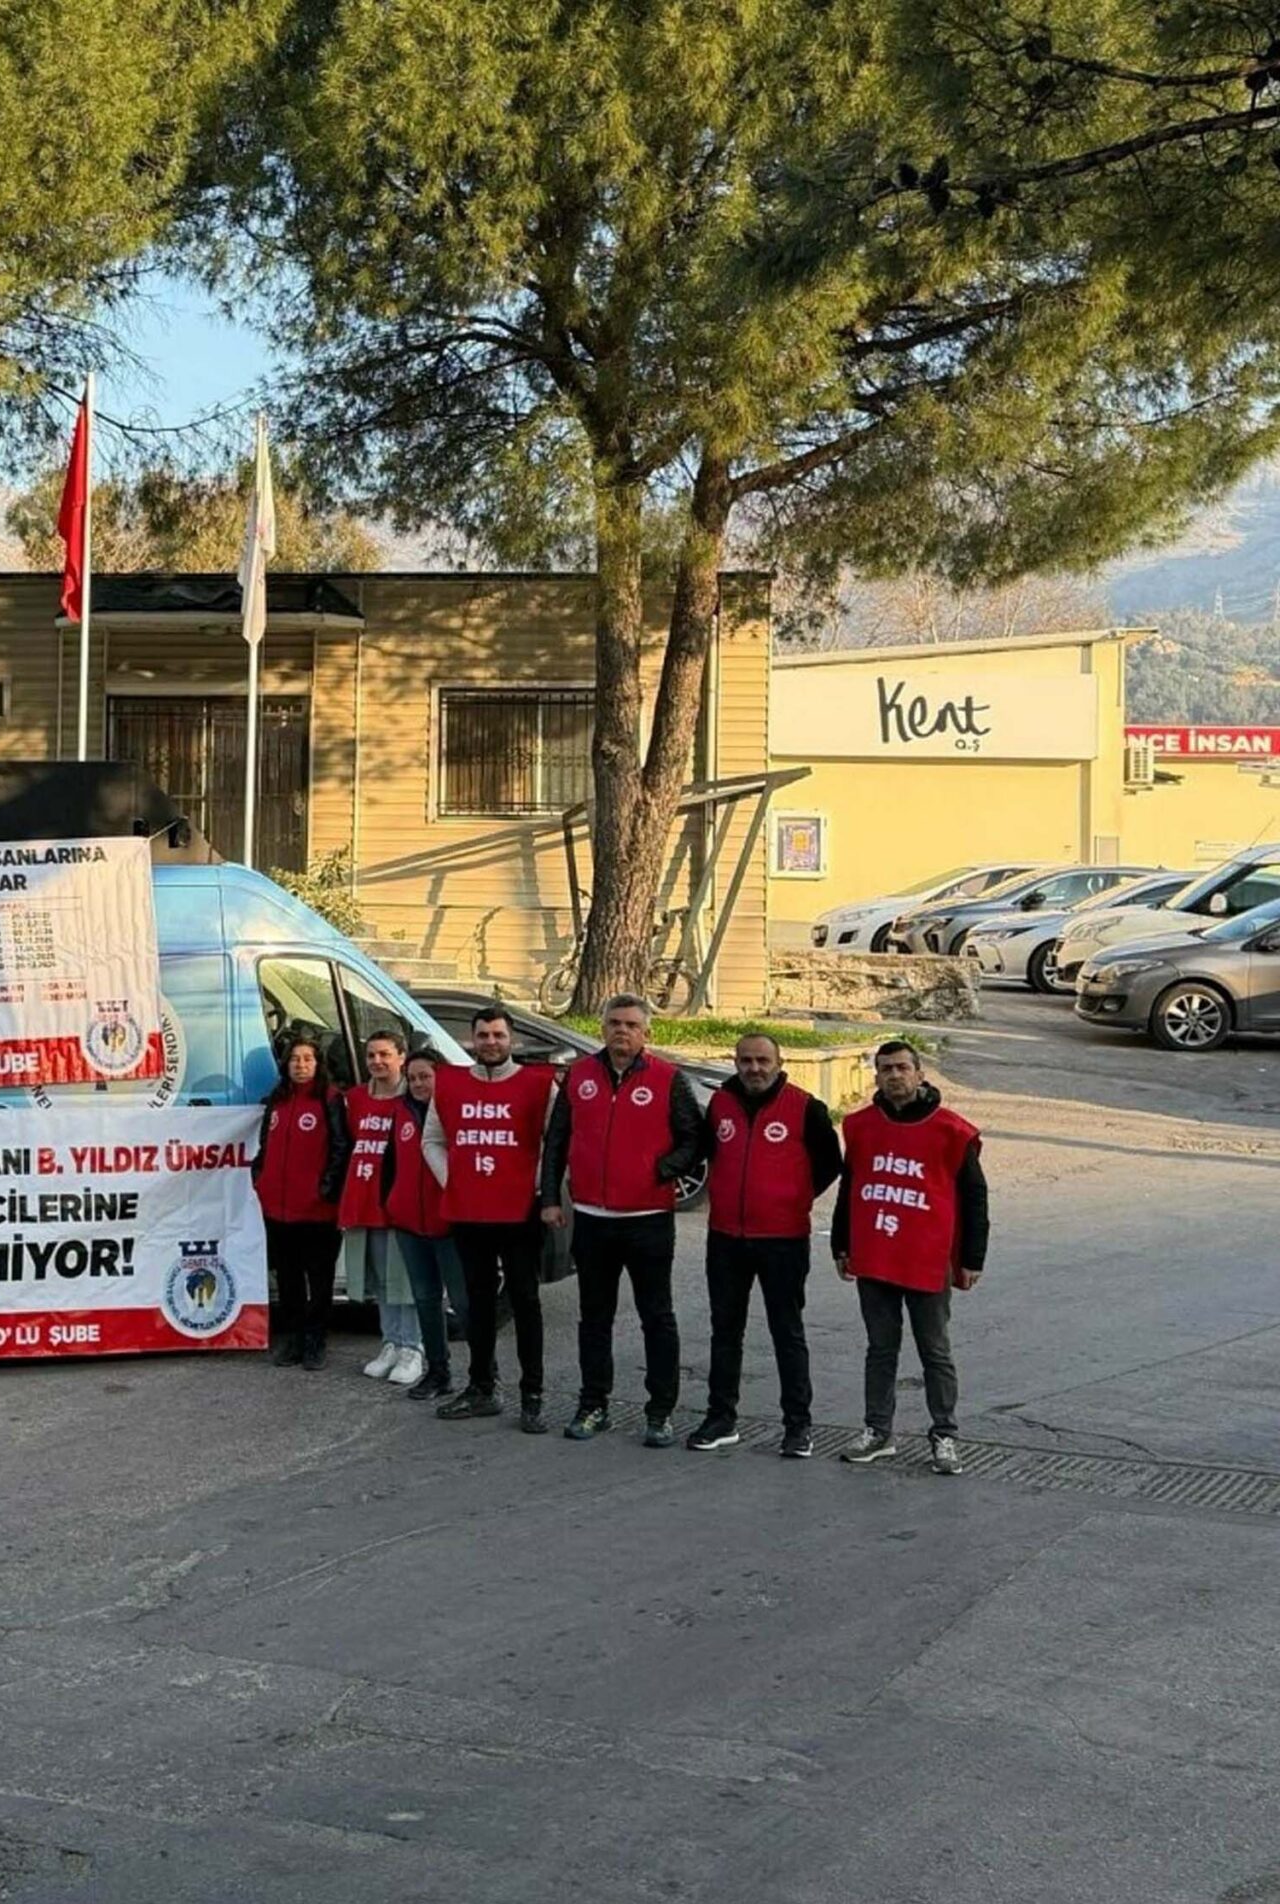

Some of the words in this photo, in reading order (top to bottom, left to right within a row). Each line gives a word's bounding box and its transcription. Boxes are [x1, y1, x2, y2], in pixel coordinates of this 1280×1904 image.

[877, 676, 991, 744] Kent
[1125, 734, 1180, 752] NCE
[1189, 729, 1271, 752] İNSAN
[461, 1100, 512, 1120] DİSK
[456, 1129, 519, 1147] GENEL
[37, 1148, 63, 1175] B.
[70, 1146, 159, 1174] YILDIZ
[165, 1139, 252, 1171] ÜNSAL
[475, 1152, 496, 1176] İŞ
[872, 1152, 925, 1180] DİSK
[356, 1160, 374, 1181] İŞ
[861, 1183, 931, 1211] GENEL
[875, 1210, 900, 1238] İŞ
[16, 1327, 40, 1345] LU
[49, 1324, 100, 1345] ŞUBE
